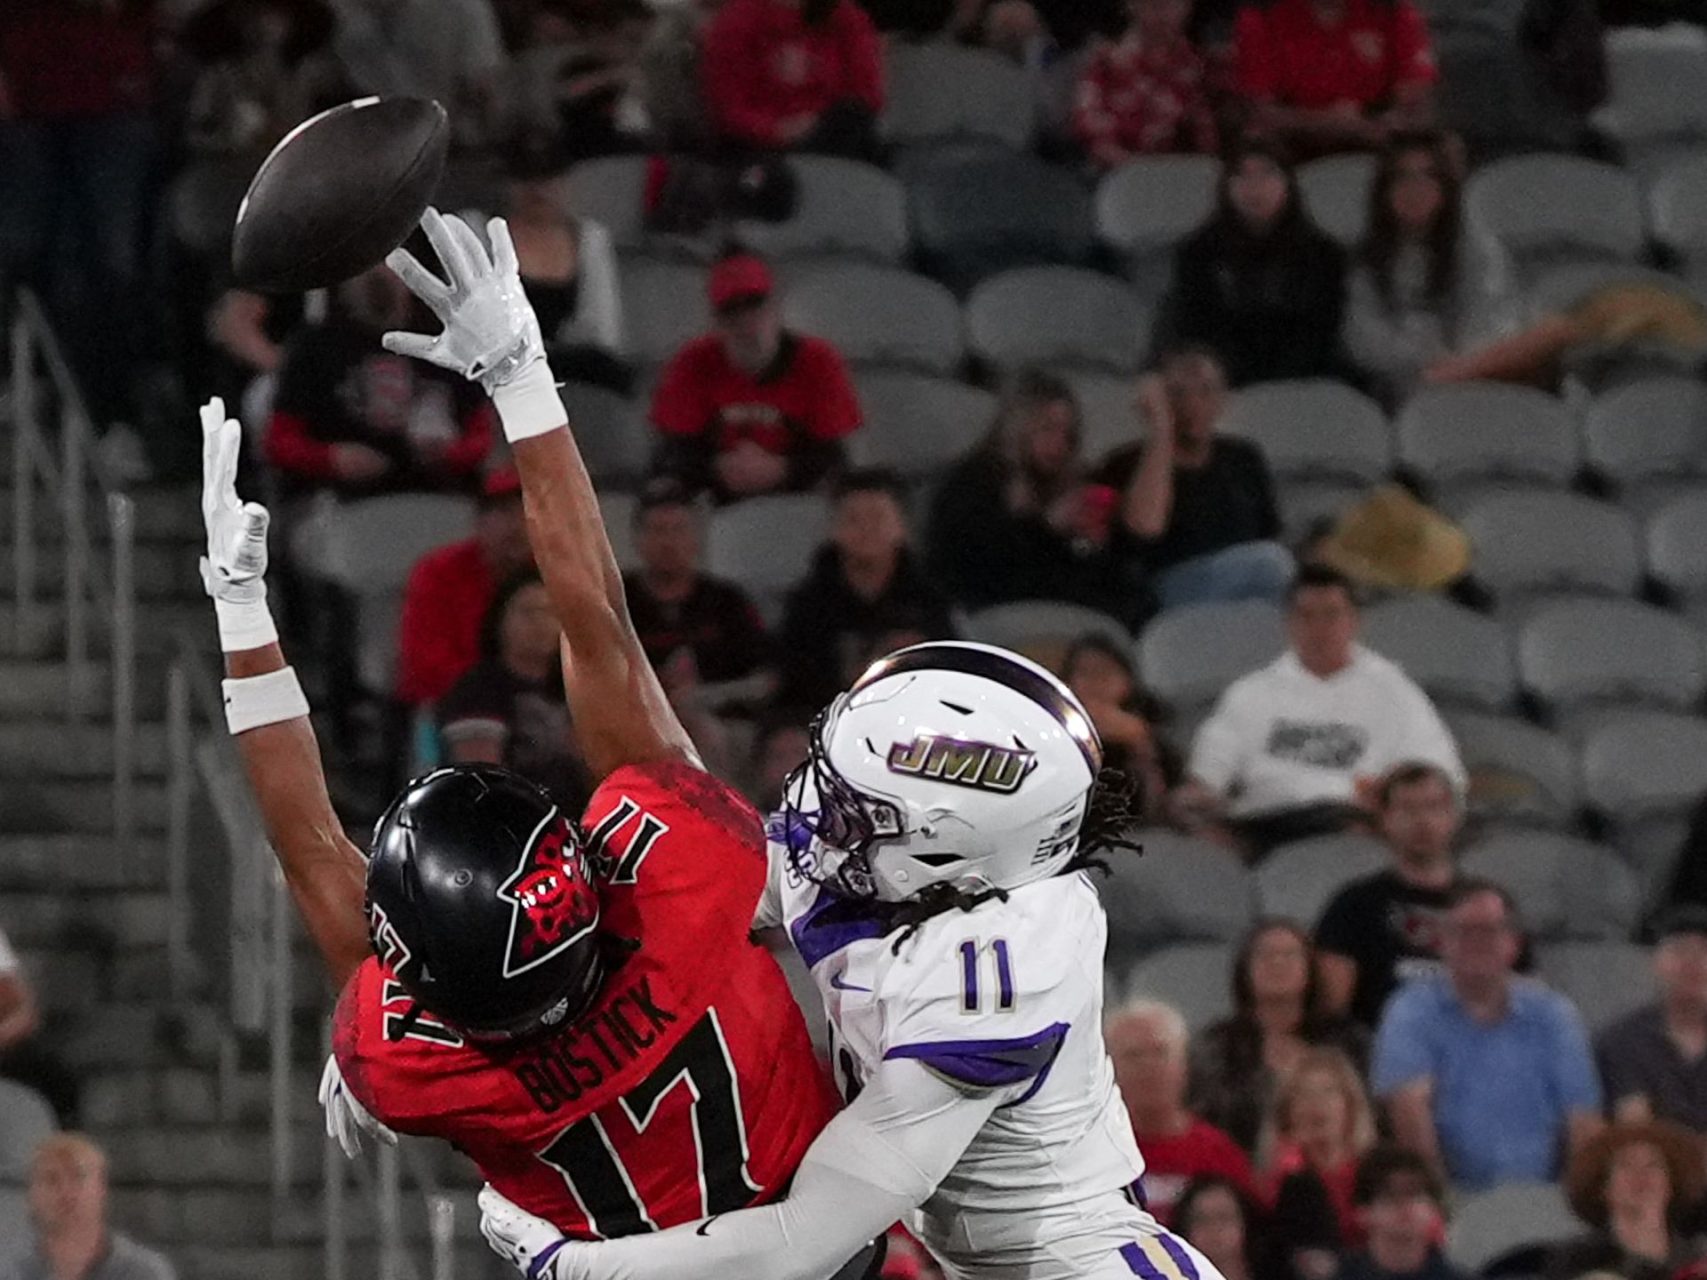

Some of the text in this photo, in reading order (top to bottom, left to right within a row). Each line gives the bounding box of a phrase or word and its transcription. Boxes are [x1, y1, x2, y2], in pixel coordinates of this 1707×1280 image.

[887, 734, 1036, 794] JMU
[957, 937, 1016, 1015] 11
[517, 977, 677, 1113] BOSTICK
[535, 1005, 764, 1241] 17
